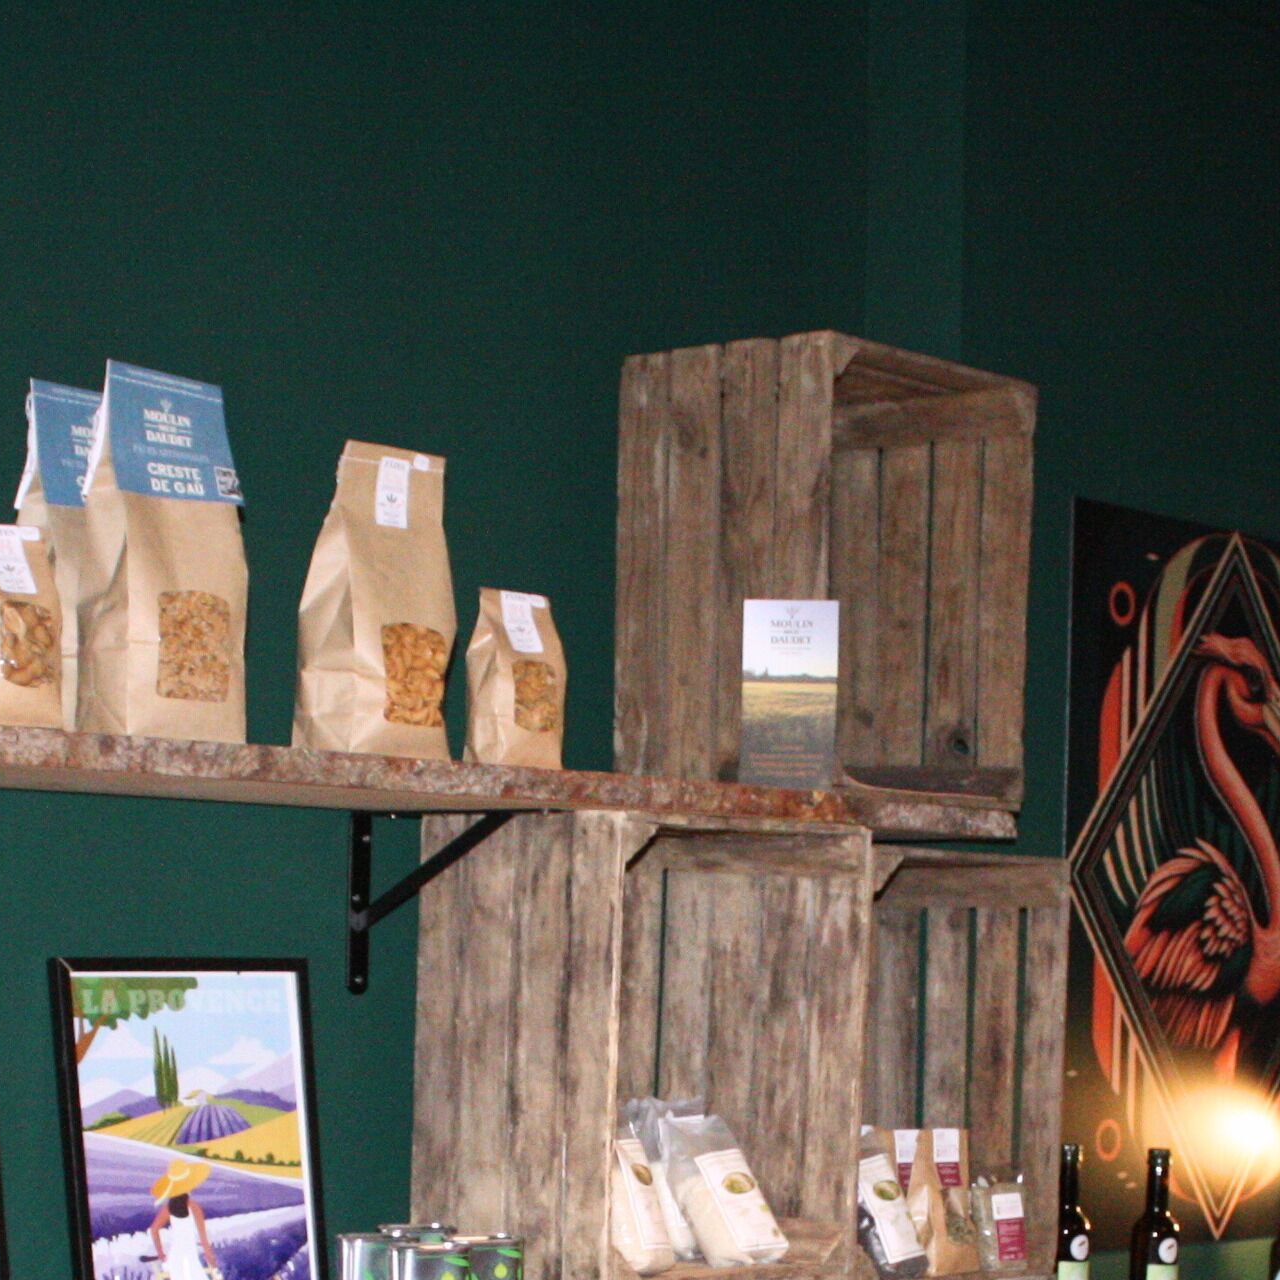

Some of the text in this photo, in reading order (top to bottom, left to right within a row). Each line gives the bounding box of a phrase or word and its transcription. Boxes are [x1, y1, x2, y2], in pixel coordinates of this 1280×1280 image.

[143, 408, 192, 428] MOULIN
[145, 430, 193, 448] DAUDET
[146, 462, 202, 480] CRESTE
[151, 477, 170, 492] DE
[81, 988, 285, 1014] LA PROVENCE
